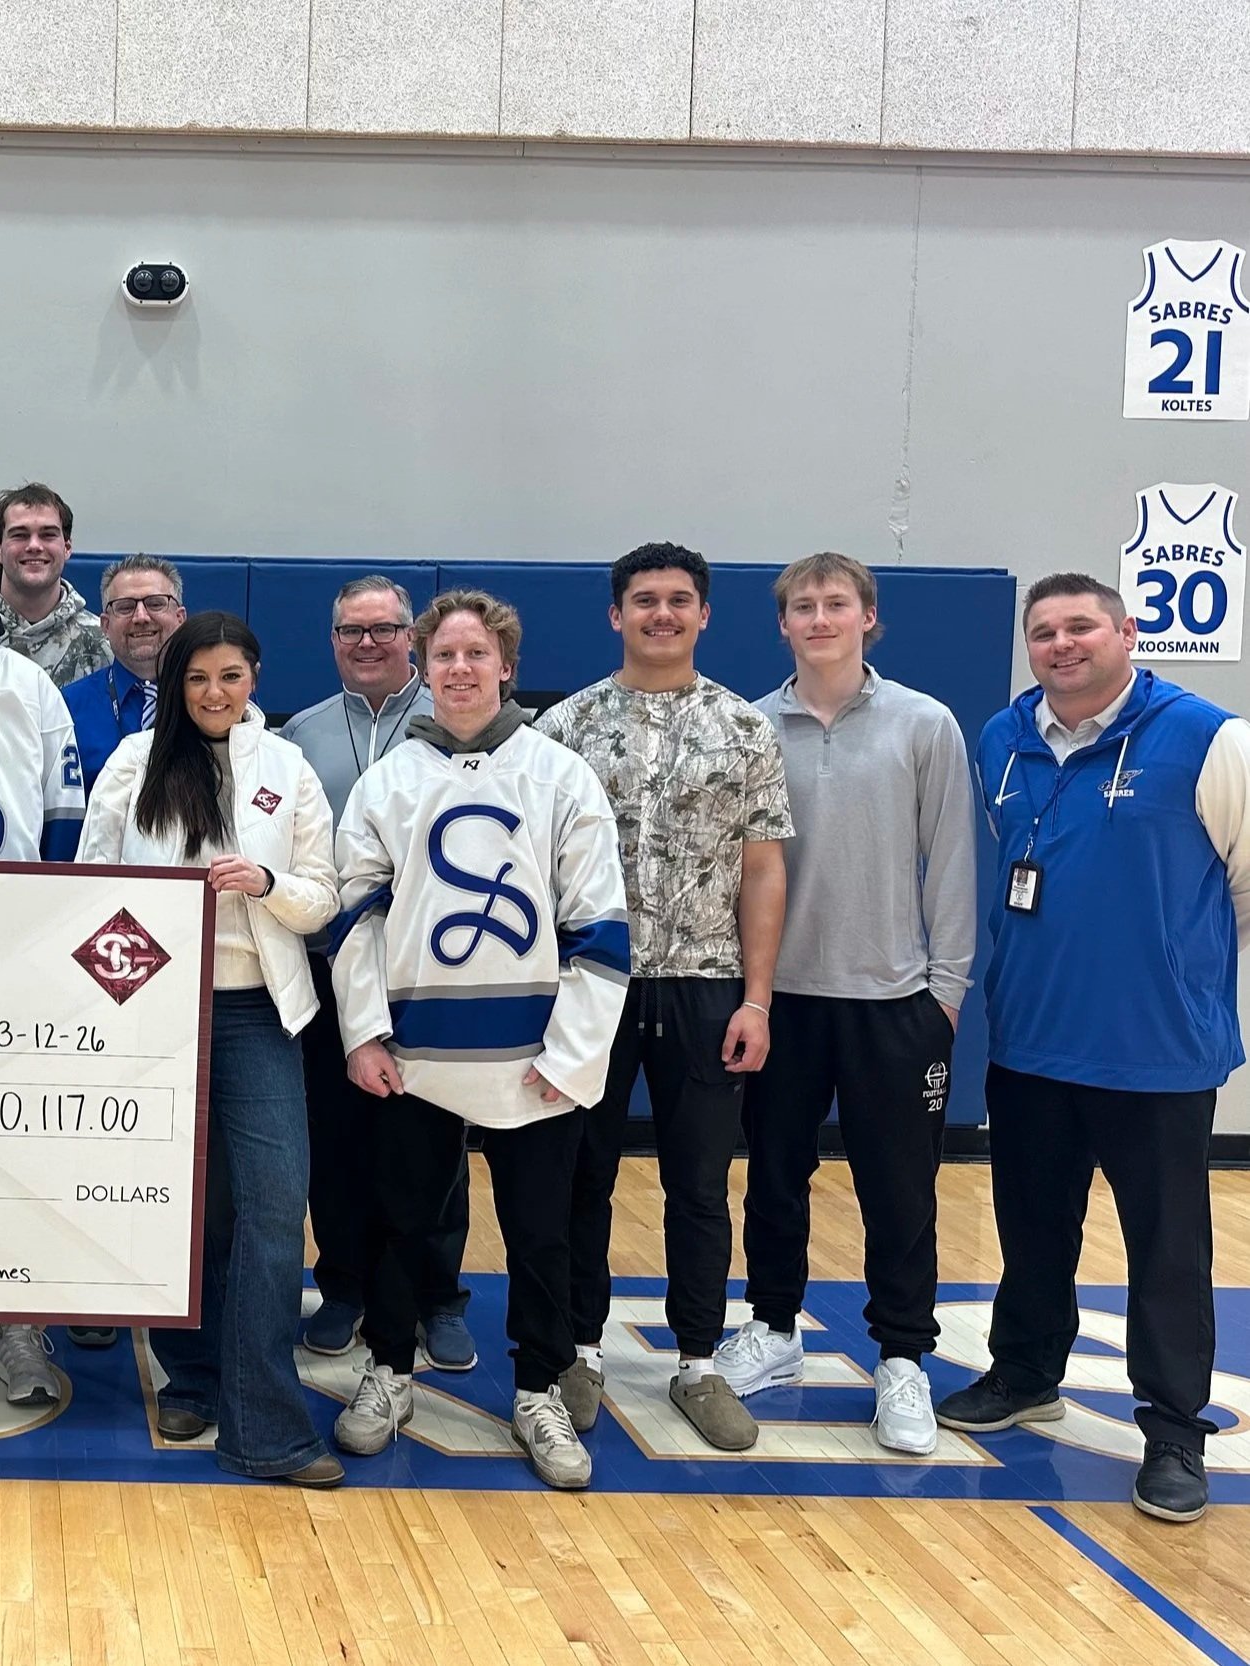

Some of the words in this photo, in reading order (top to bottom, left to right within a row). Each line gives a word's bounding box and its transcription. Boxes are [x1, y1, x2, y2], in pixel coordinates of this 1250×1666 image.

[1148, 301, 1234, 325] SABRES
[1148, 328, 1223, 395] 21
[1161, 399, 1212, 413] KOLTES
[1141, 544, 1226, 567] SABRES
[1135, 568, 1228, 636] 30
[1137, 640, 1220, 654] KOOSMANN
[927, 1097, 943, 1112] 20
[76, 1184, 170, 1204] DOLLARS
